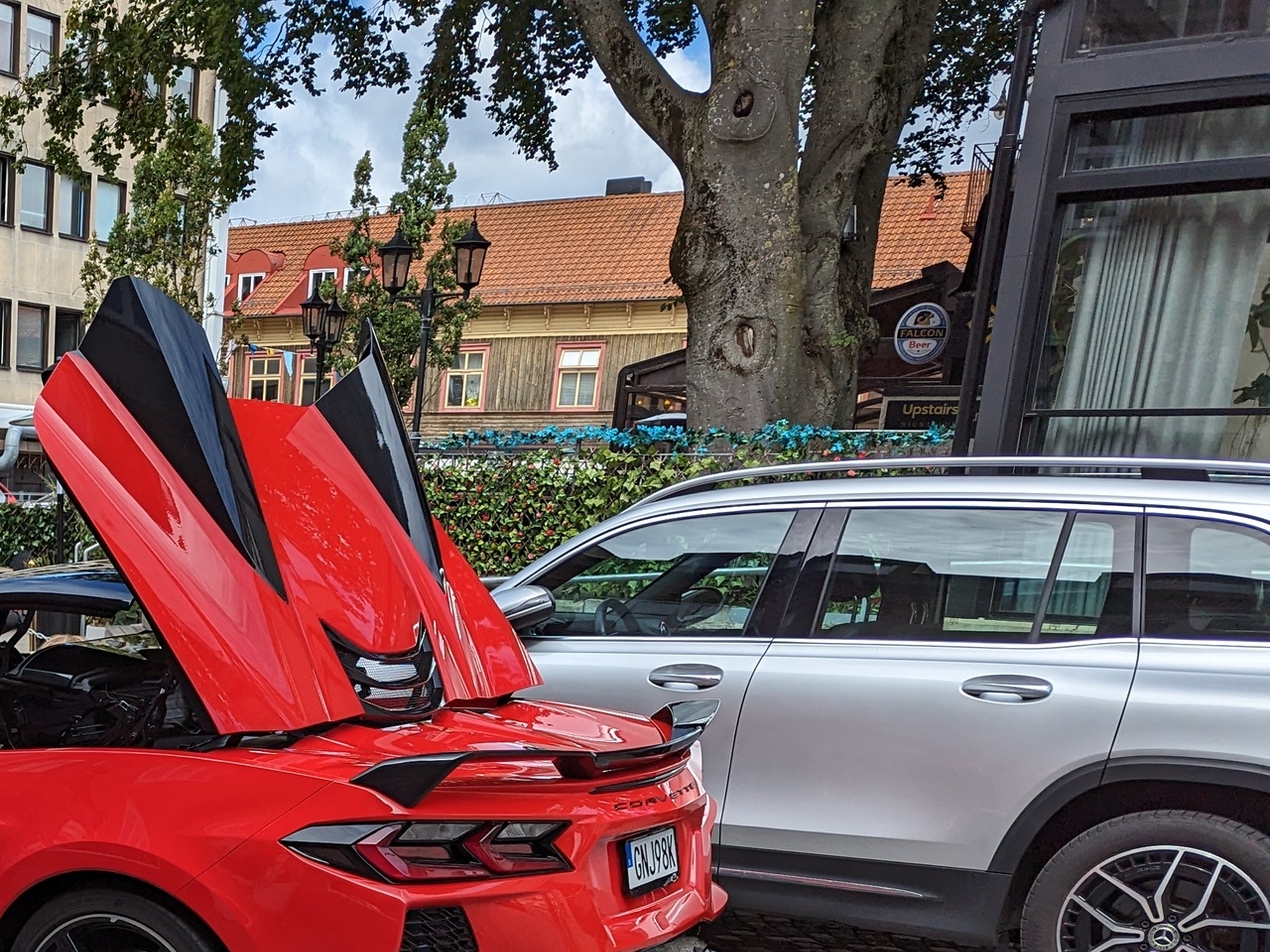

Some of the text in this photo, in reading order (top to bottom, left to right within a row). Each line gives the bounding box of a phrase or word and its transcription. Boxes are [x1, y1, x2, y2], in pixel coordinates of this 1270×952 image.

[900, 329, 944, 338] FALCON
[909, 340, 931, 349] Beer
[902, 403, 959, 419] Upstairs
[614, 782, 696, 811] CORVETTE
